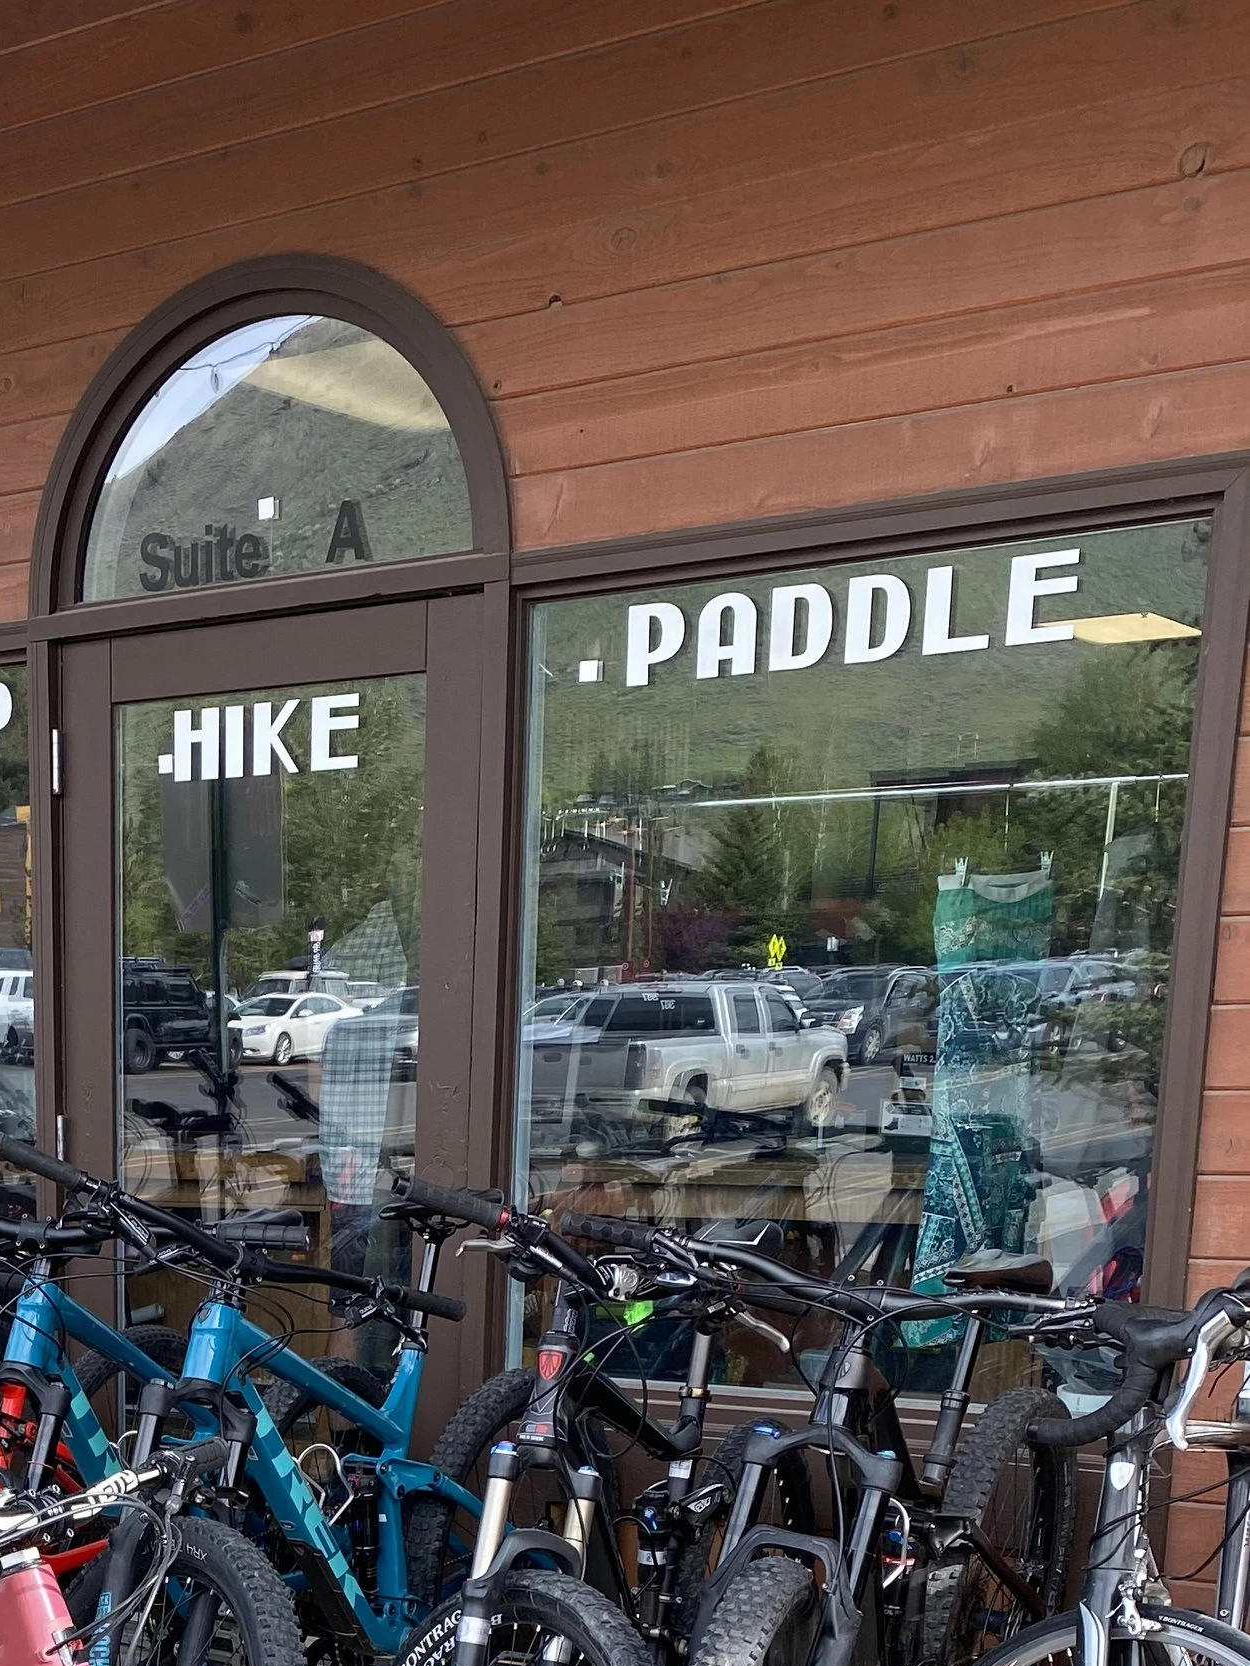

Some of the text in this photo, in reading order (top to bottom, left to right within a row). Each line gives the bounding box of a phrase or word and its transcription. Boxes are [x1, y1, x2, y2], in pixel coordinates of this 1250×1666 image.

[139, 499, 368, 592] Suite A
[626, 547, 1081, 687] PADDLE
[1161, 1615, 1205, 1633] BONTRAGER
